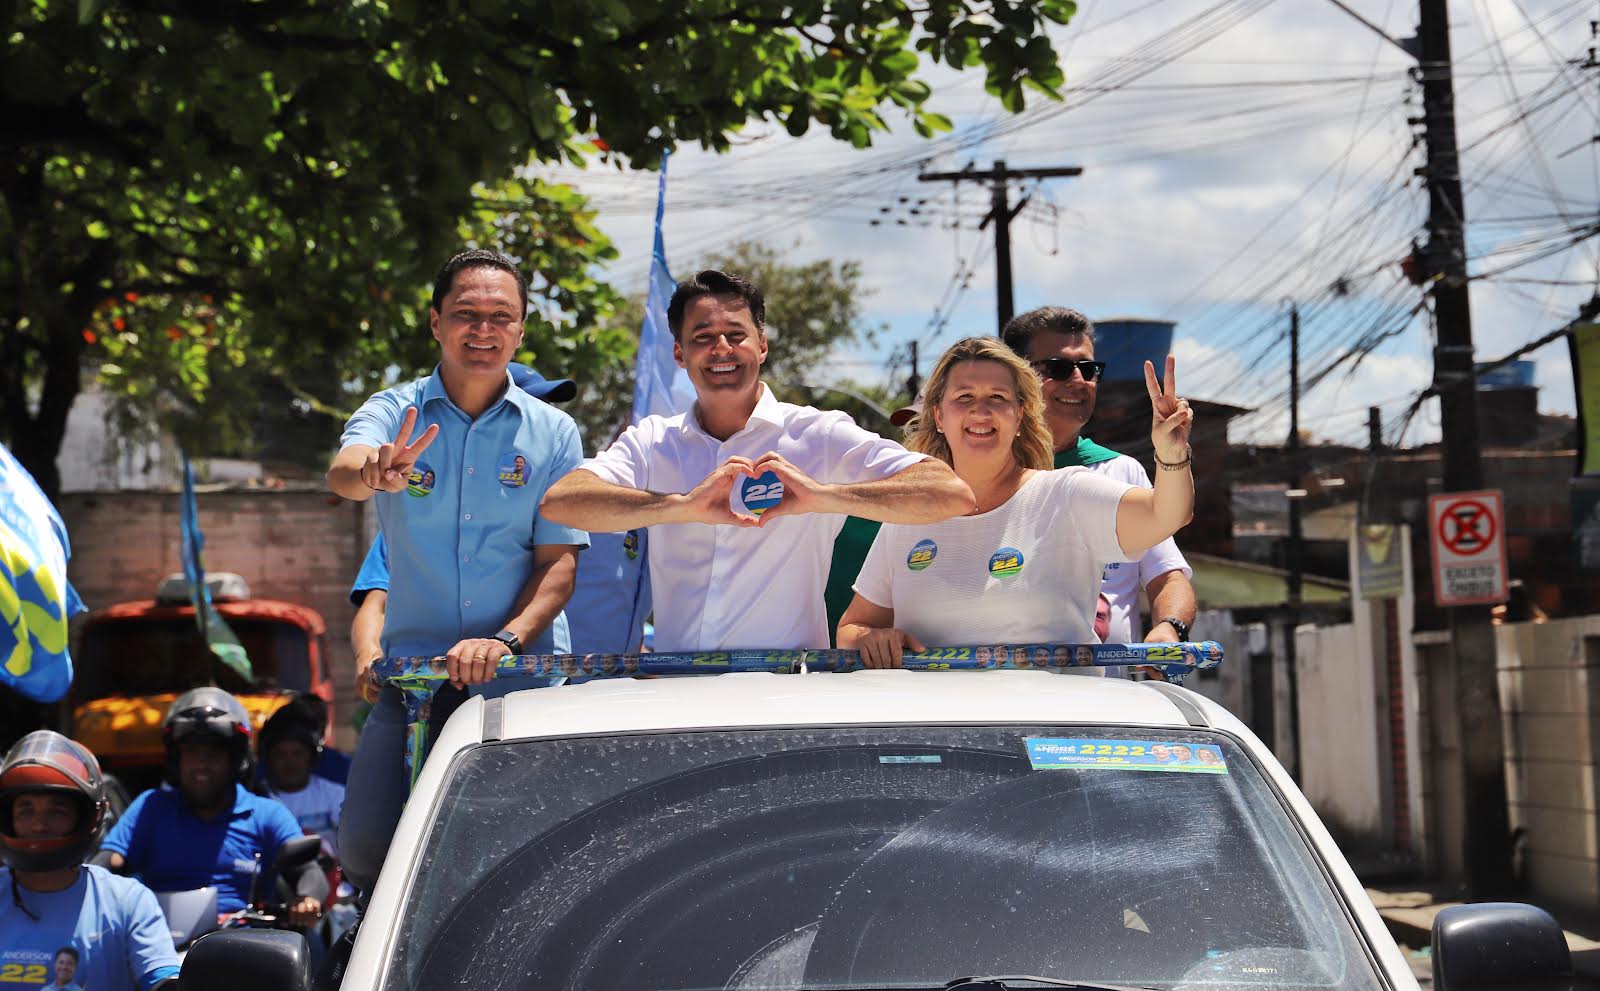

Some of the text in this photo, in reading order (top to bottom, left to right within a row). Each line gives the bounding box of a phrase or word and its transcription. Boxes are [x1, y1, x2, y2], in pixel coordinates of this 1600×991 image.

[743, 481, 785, 503] 22
[909, 550, 932, 562] 22
[992, 557, 1018, 571] 22
[692, 652, 729, 666] 22
[915, 647, 971, 660] 2222
[1096, 646, 1183, 661] ANDERSON 22
[1034, 744, 1145, 756] ANDRÉ 2222
[3, 951, 53, 961] ANDERSON
[0, 963, 48, 984] 22
